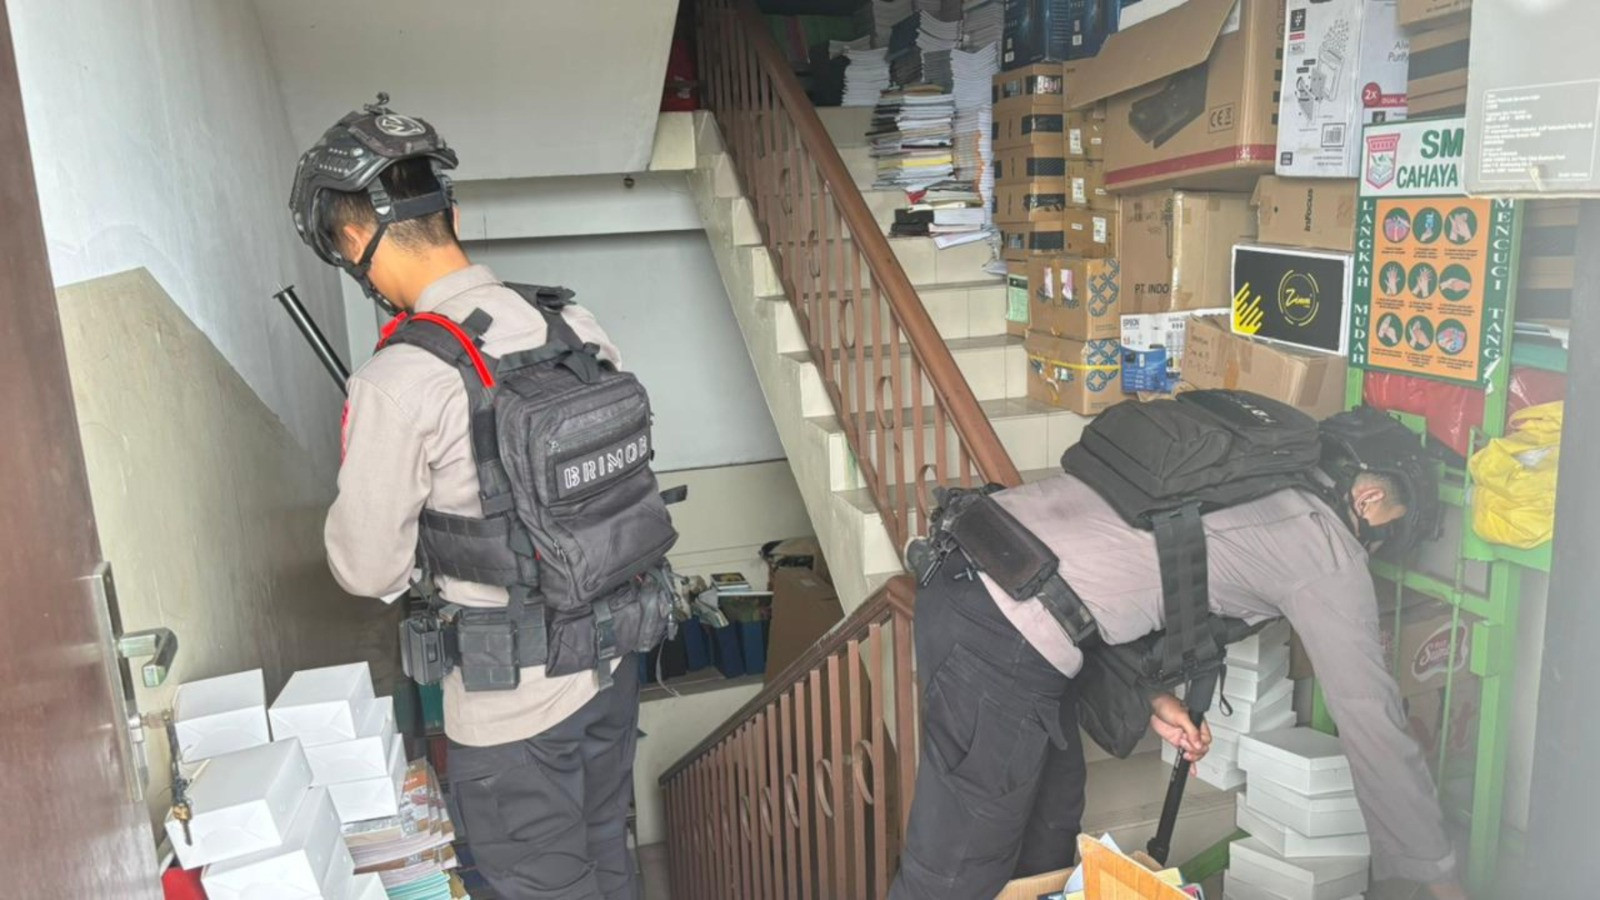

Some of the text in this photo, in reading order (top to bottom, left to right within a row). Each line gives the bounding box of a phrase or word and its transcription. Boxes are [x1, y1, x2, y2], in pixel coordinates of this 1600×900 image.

[1396, 163, 1458, 189] CAHAYA
[1352, 200, 1374, 364] LANGKAH MUDAH
[1484, 198, 1514, 368] MENCUCI TANG
[563, 434, 648, 490] BRIMOB
